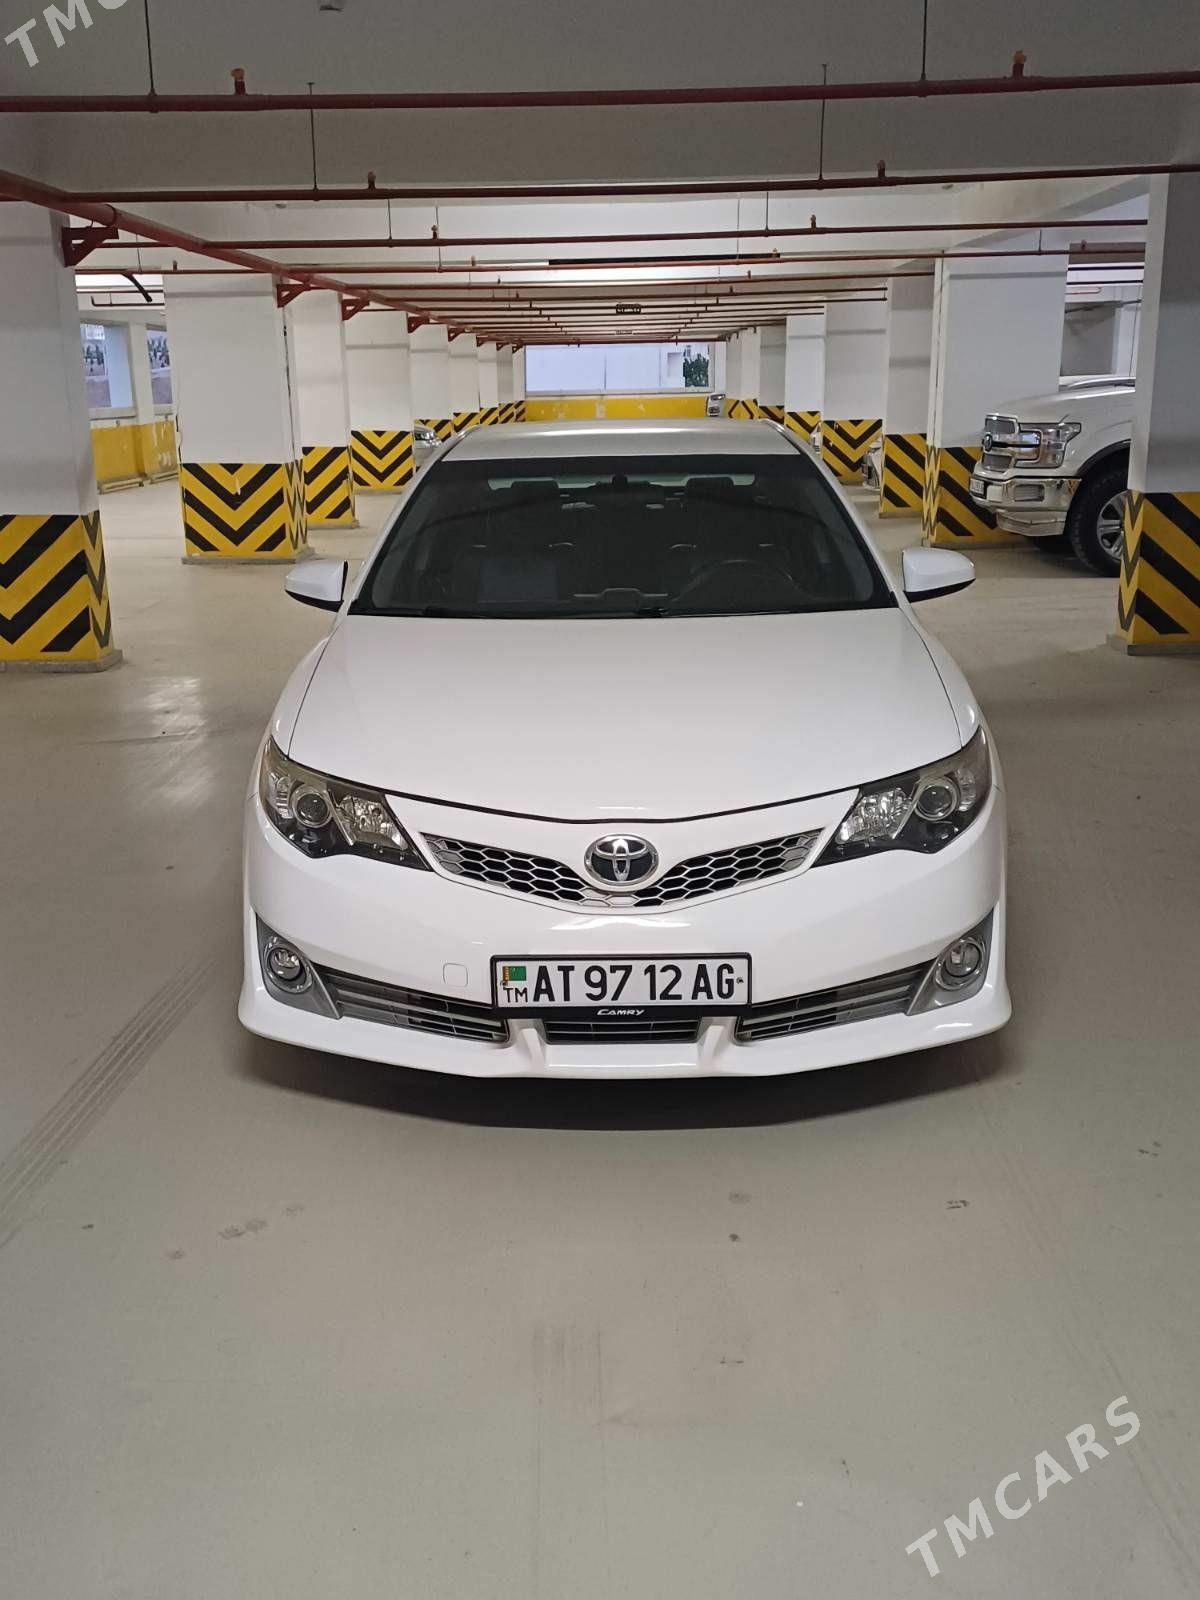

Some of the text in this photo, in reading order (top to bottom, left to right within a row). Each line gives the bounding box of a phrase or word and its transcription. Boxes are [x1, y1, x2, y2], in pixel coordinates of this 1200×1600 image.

[533, 963, 734, 1002] AT 97 12 AG
[503, 987, 528, 1003] TM
[597, 1008, 645, 1016] CAMRY
